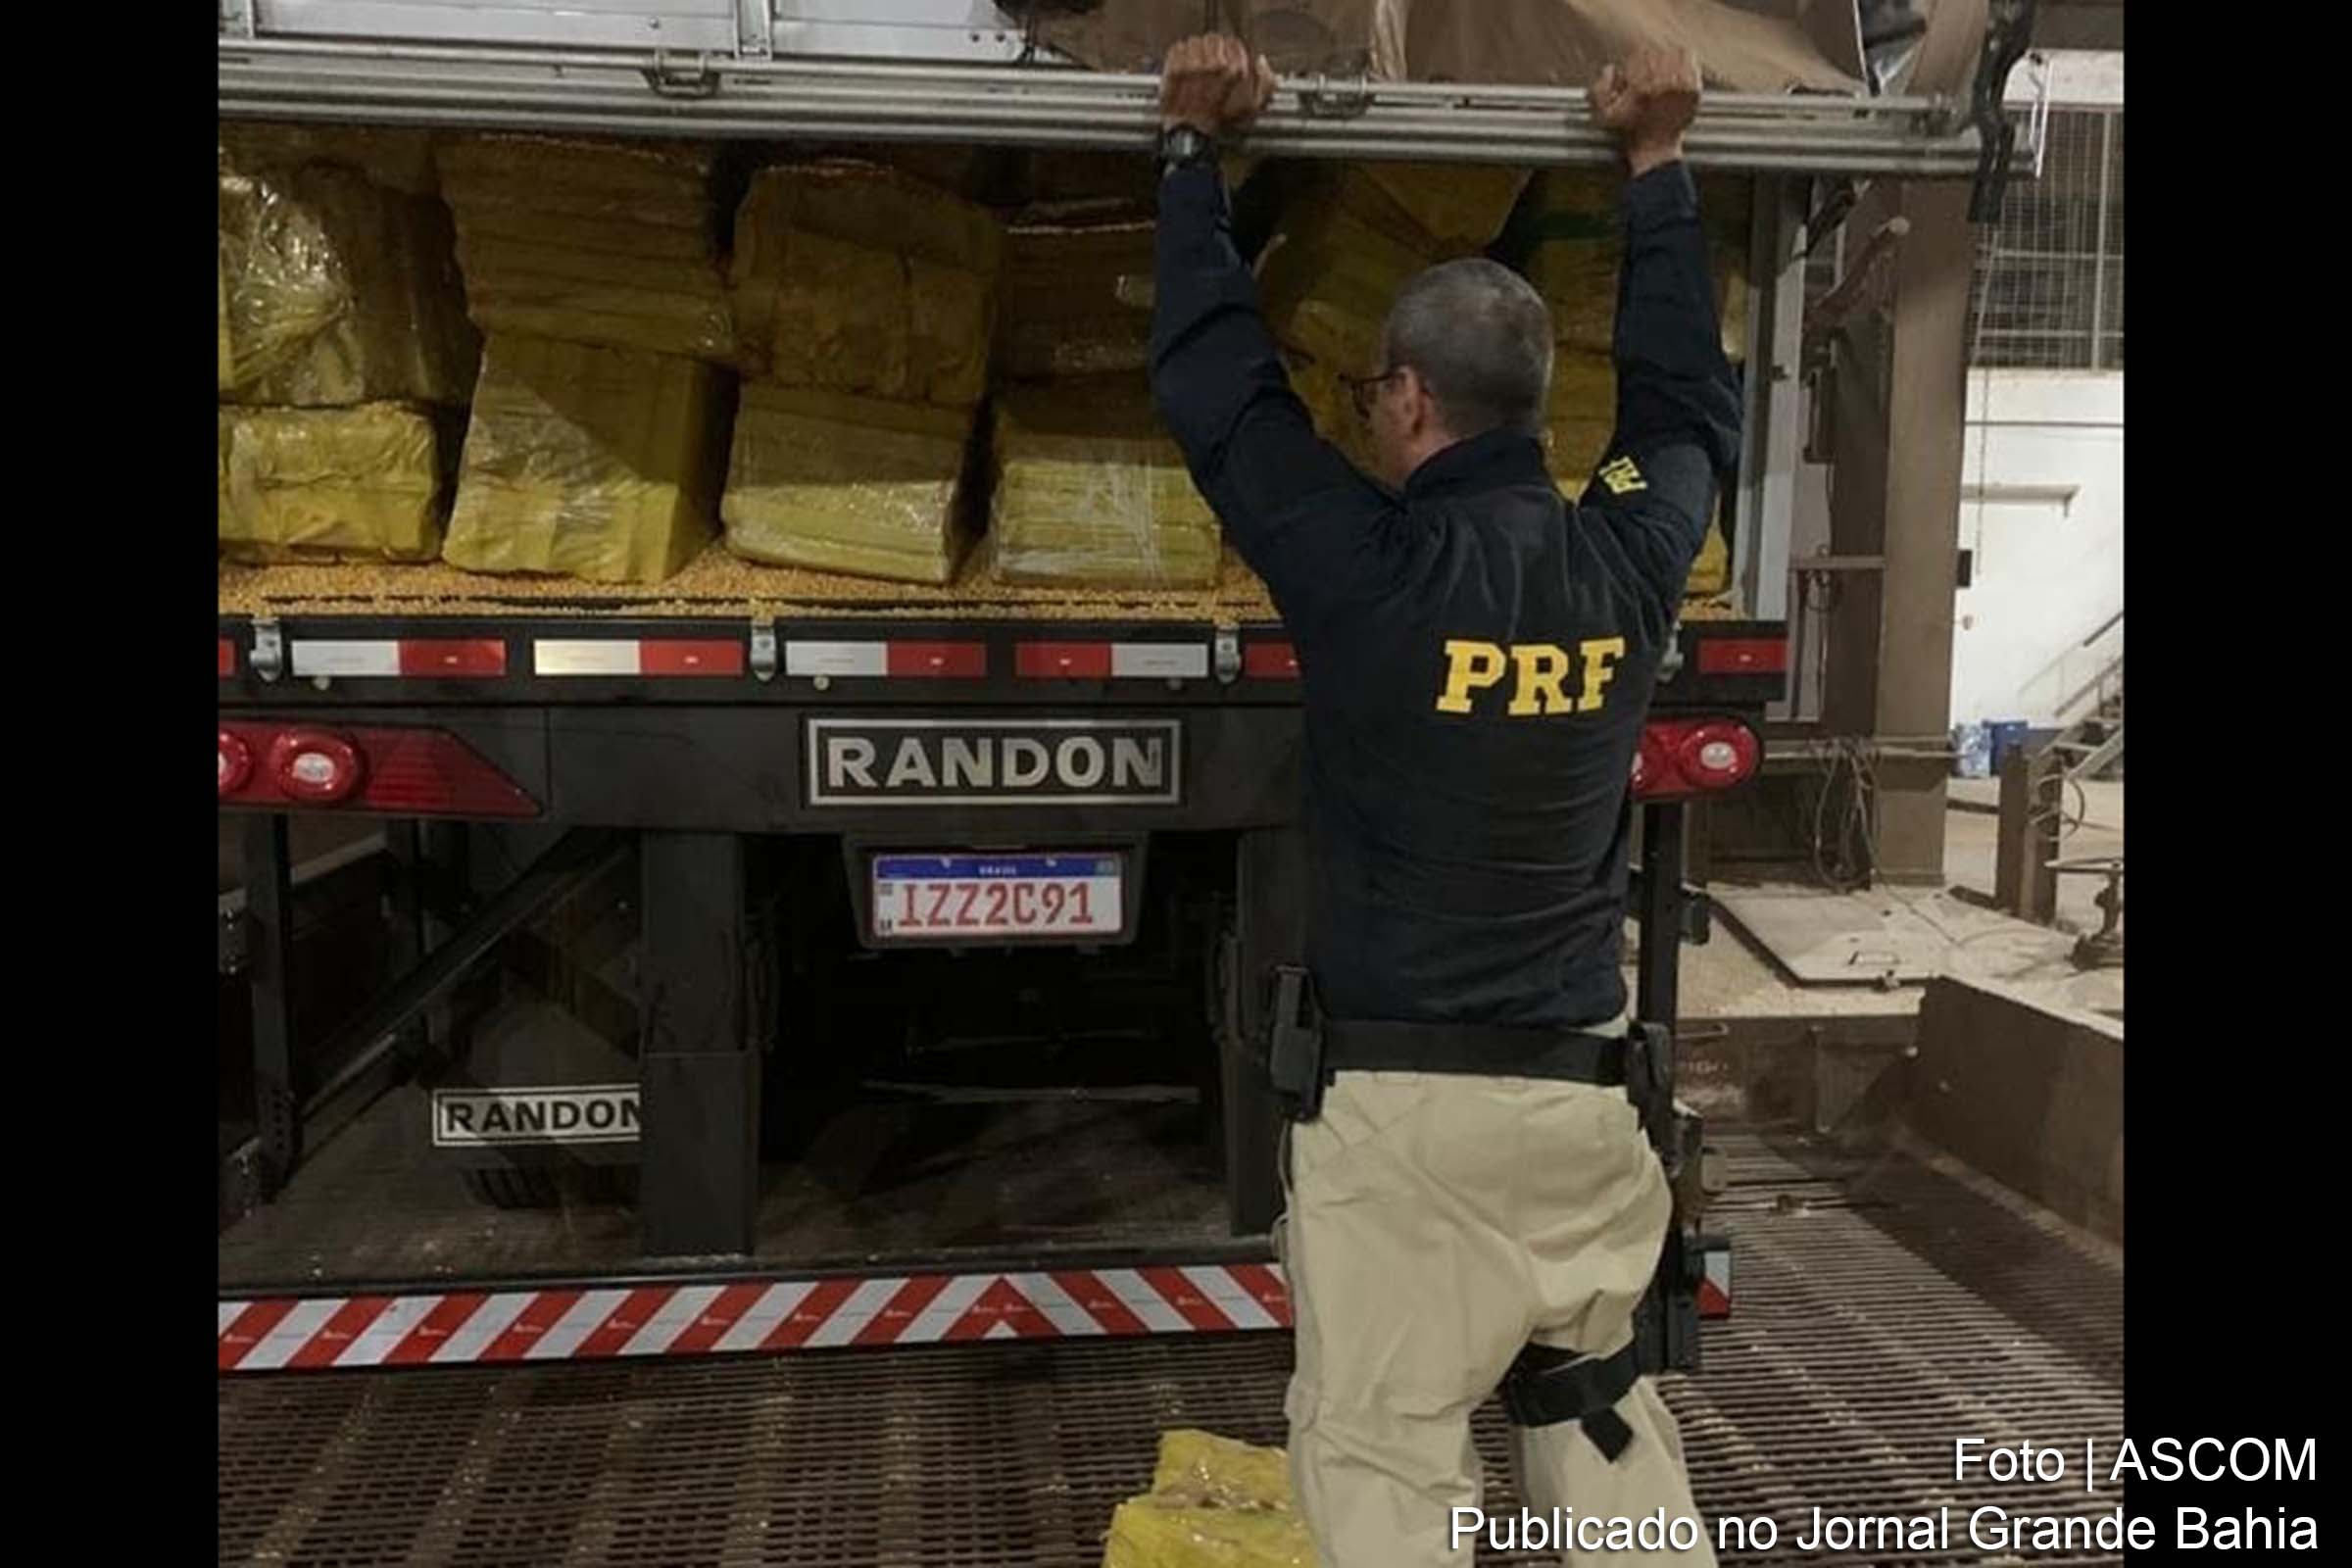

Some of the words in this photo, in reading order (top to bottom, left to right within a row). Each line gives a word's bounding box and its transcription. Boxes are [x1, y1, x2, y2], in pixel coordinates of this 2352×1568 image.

[1436, 636, 1626, 716] PRF
[827, 736, 1164, 788] RANDON
[898, 881, 1094, 927] IZZ2C91
